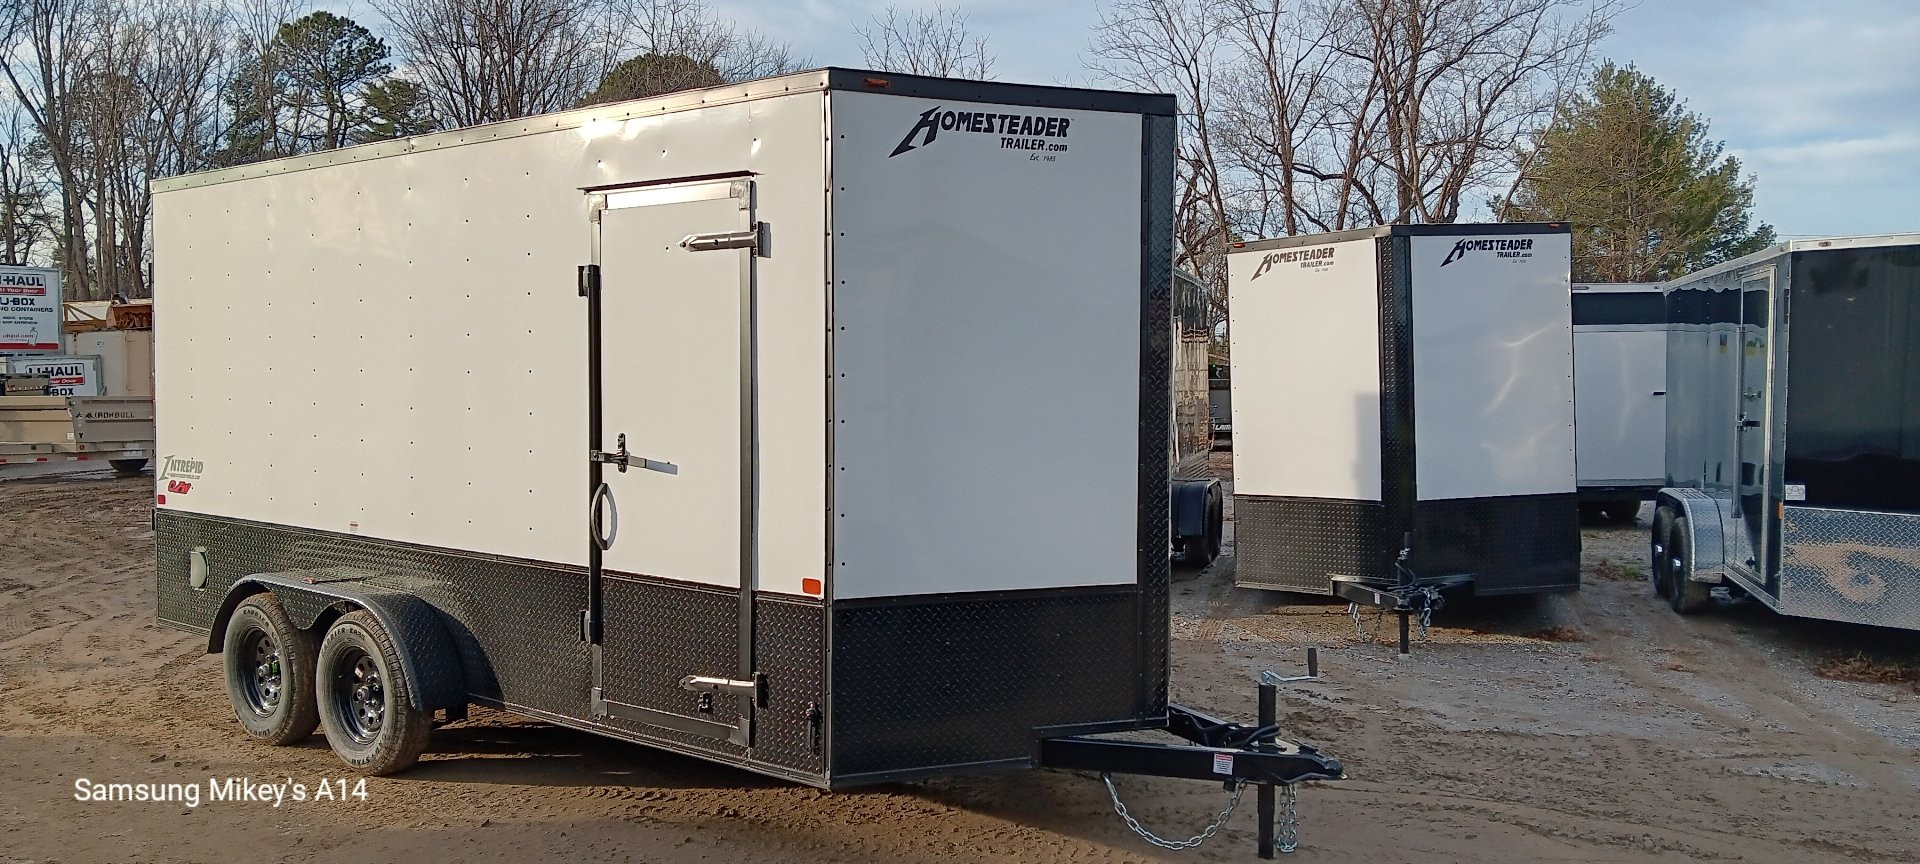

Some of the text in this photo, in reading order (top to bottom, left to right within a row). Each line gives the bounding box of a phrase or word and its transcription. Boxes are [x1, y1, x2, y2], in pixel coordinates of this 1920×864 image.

[888, 105, 1071, 158] HOMESTEADER
[1000, 137, 1069, 152] TRAILER.com
[1250, 247, 1335, 282] HOMESTEADER
[1440, 238, 1533, 268] HOMESTEADER
[158, 454, 204, 482] INTREPID
